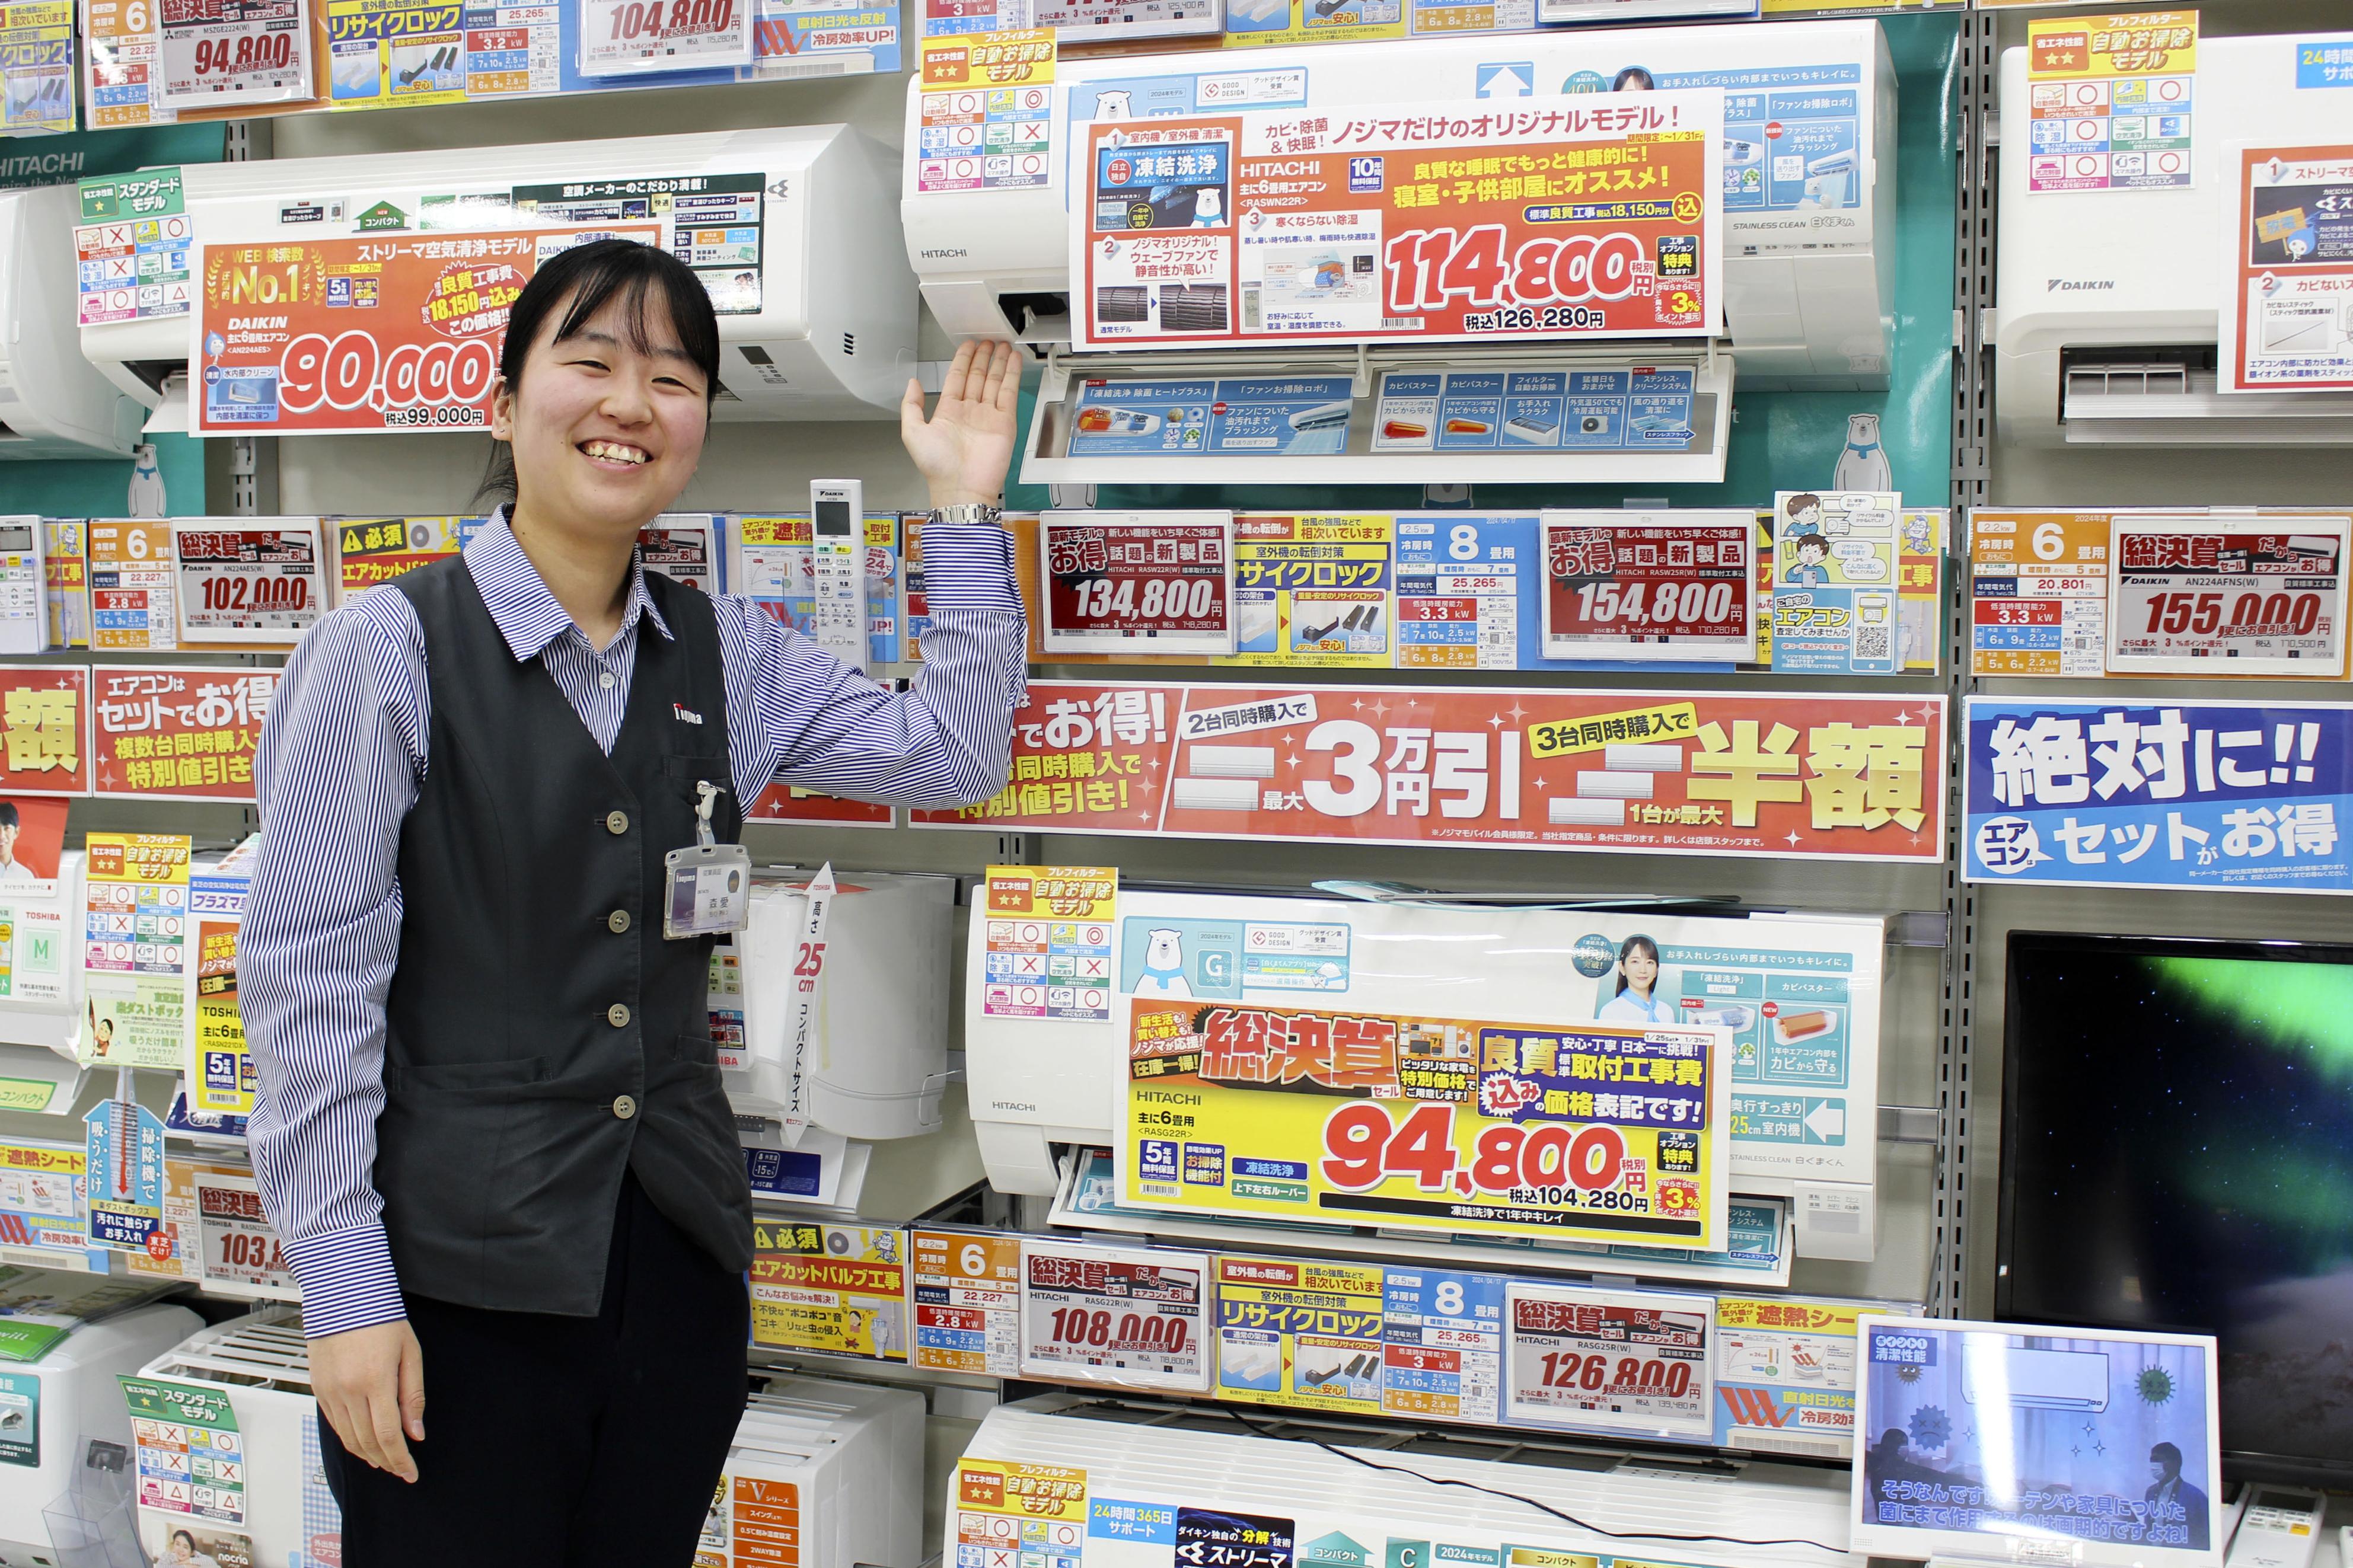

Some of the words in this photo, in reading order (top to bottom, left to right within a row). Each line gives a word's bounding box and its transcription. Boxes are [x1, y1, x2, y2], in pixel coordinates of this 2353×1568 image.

[126, 2, 146, 32] 6
[332, 7, 460, 39] リサイクロック
[797, 12, 886, 29] 直射日光を反射
[2109, 14, 2182, 27] プレフィルター
[483, 38, 506, 49] 3.2
[813, 30, 894, 45] 冷房効率UP!
[985, 31, 1044, 40] プレフィルター
[2091, 28, 2192, 53] 自動お掃除
[971, 41, 1053, 66] 自動お掃除
[2112, 51, 2167, 70] モデル
[986, 63, 1032, 81] モデル
[1772, 97, 1853, 110] 「ファンお掃除ロボ」
[1786, 126, 1842, 134] ファンについた
[1790, 143, 1838, 151] ブラッシング
[0, 152, 84, 177] HITACHI
[1135, 157, 1217, 177] 凍結洗浄
[1241, 161, 1319, 177] HITACHI
[119, 179, 179, 199] スタンダード
[563, 178, 707, 197] 空調メーカーのこだわり満載!
[1240, 180, 1326, 196] 主に6畳用エアコン
[132, 197, 165, 212] モデル
[365, 216, 399, 227] コンパクト
[1276, 215, 1358, 227] 寒くならない除湿
[232, 250, 261, 263] WEB
[266, 248, 304, 261] 検索数
[358, 238, 532, 261] ストリーマ空気清浄モデル
[921, 249, 968, 259] HITACHI
[1131, 251, 1218, 263] ウェーブファンで
[1385, 224, 1645, 311] 114,800
[233, 265, 298, 304] No.1
[2062, 281, 2114, 290] DAIKIN
[228, 317, 287, 330] DAIKIN
[277, 330, 494, 413] 90,000
[1388, 382, 1435, 390] カビバスター
[1633, 397, 1684, 405] 風の通り道を
[1225, 416, 1270, 426] 油汚れまで
[1224, 426, 1278, 435] ブラッシング
[1300, 527, 1385, 539] 相次いでいます
[2032, 523, 2064, 560] 6
[182, 534, 240, 558] 総決算
[1401, 541, 1433, 551] 冷房時
[1449, 525, 1479, 560] 8
[1979, 539, 2014, 549] 冷房時
[1050, 540, 1106, 574] お得
[1108, 540, 1222, 563] 話題の新製品
[1257, 546, 1344, 558] 室外機の転倒対策
[1550, 540, 1614, 577] お得
[2124, 536, 2224, 567] 総決算
[1650, 569, 1696, 577] RASW25R(W)
[1075, 579, 1213, 621] 134,800
[1577, 583, 1733, 626] 154,800
[1990, 602, 2046, 611] 低温時暖房能力
[1420, 608, 1448, 619] 3.3
[1455, 610, 1469, 619] kW
[1776, 608, 1850, 628] エアコン
[1998, 610, 2029, 623] 3.3
[2038, 612, 2054, 622] kW
[2146, 593, 2320, 638] 155,000
[1775, 627, 1850, 638] 査定してみませんか
[108, 676, 185, 696] エアコンは
[1187, 704, 1308, 733] 2台同時購入で
[1538, 711, 1691, 751] 3台同時購入で
[1989, 709, 2320, 807] 絶対に!!
[1688, 720, 1925, 830] 半額
[1262, 791, 1303, 811] 最大
[1630, 804, 1723, 824] 1台が最大
[2054, 804, 2337, 866] セットがお得
[125, 847, 188, 864] 自動お掃除
[138, 864, 171, 878] モデル
[1048, 868, 1104, 877] プレフィルター
[1035, 880, 1113, 899] 自動お掃除
[1050, 899, 1093, 916] モデル
[26, 912, 60, 921] TOSHIBA
[794, 943, 825, 976] 25
[1782, 983, 1833, 992] カビバスター
[1199, 1008, 1401, 1088] 総決算
[791, 1004, 808, 1112] コンパクトサイズ
[1771, 1058, 1836, 1073] カビから守る
[1571, 1056, 1702, 1086] 取付工事費
[993, 1101, 1036, 1112] HITACHI
[1136, 1091, 1201, 1106] HITACHI
[1138, 1112, 1194, 1127] 主に6畳用
[91, 1121, 103, 1194] 吸うだけ
[1319, 1101, 1628, 1199] 94,800
[141, 1128, 157, 1200] 掃除機で
[1246, 1161, 1295, 1177] 凍結洗浄
[1233, 1183, 1306, 1197] 上下左右ルーバー
[97, 1213, 152, 1230] 汚れに触らず
[1451, 1206, 1564, 1223] 凍結洗浄で1年中キレイ
[105, 1228, 143, 1242] お手入れ
[776, 1227, 819, 1250] 必須
[960, 1244, 986, 1276] 6
[752, 1259, 901, 1291] エアカットバルブ工事
[1031, 1257, 1110, 1289] 総決算
[1227, 1266, 1293, 1282] 室外機の転倒が
[1031, 1292, 1069, 1302] HITACHI
[1085, 1297, 1133, 1308] RASG22R(W)
[1261, 1291, 1347, 1308] 室外機の転倒対策
[1435, 1281, 1465, 1315] 8
[935, 1316, 960, 1328] 2.8
[1224, 1304, 1381, 1337] リサイクロック
[1517, 1302, 1605, 1334] 総決算
[1052, 1308, 1187, 1353] 108,000
[1516, 1336, 1560, 1346] HITACHI
[1578, 1341, 1631, 1353] RASG25R(W)
[1875, 1349, 1926, 1363] 清潔性能
[1541, 1353, 1691, 1397] 126,800
[164, 1390, 228, 1408] スタンダード
[181, 1405, 216, 1421] モデル
[1006, 1476, 1085, 1500] 自動お掃除
[766, 1495, 789, 1504] シリーズ
[1021, 1496, 1064, 1515] モデル
[1094, 1504, 1171, 1524] 24時間365日
[1109, 1522, 1155, 1537] サポート
[218, 1554, 247, 1564] nocria
[1441, 1547, 1495, 1563] 2024年モデル
[1537, 1555, 1576, 1566] コンパクト
